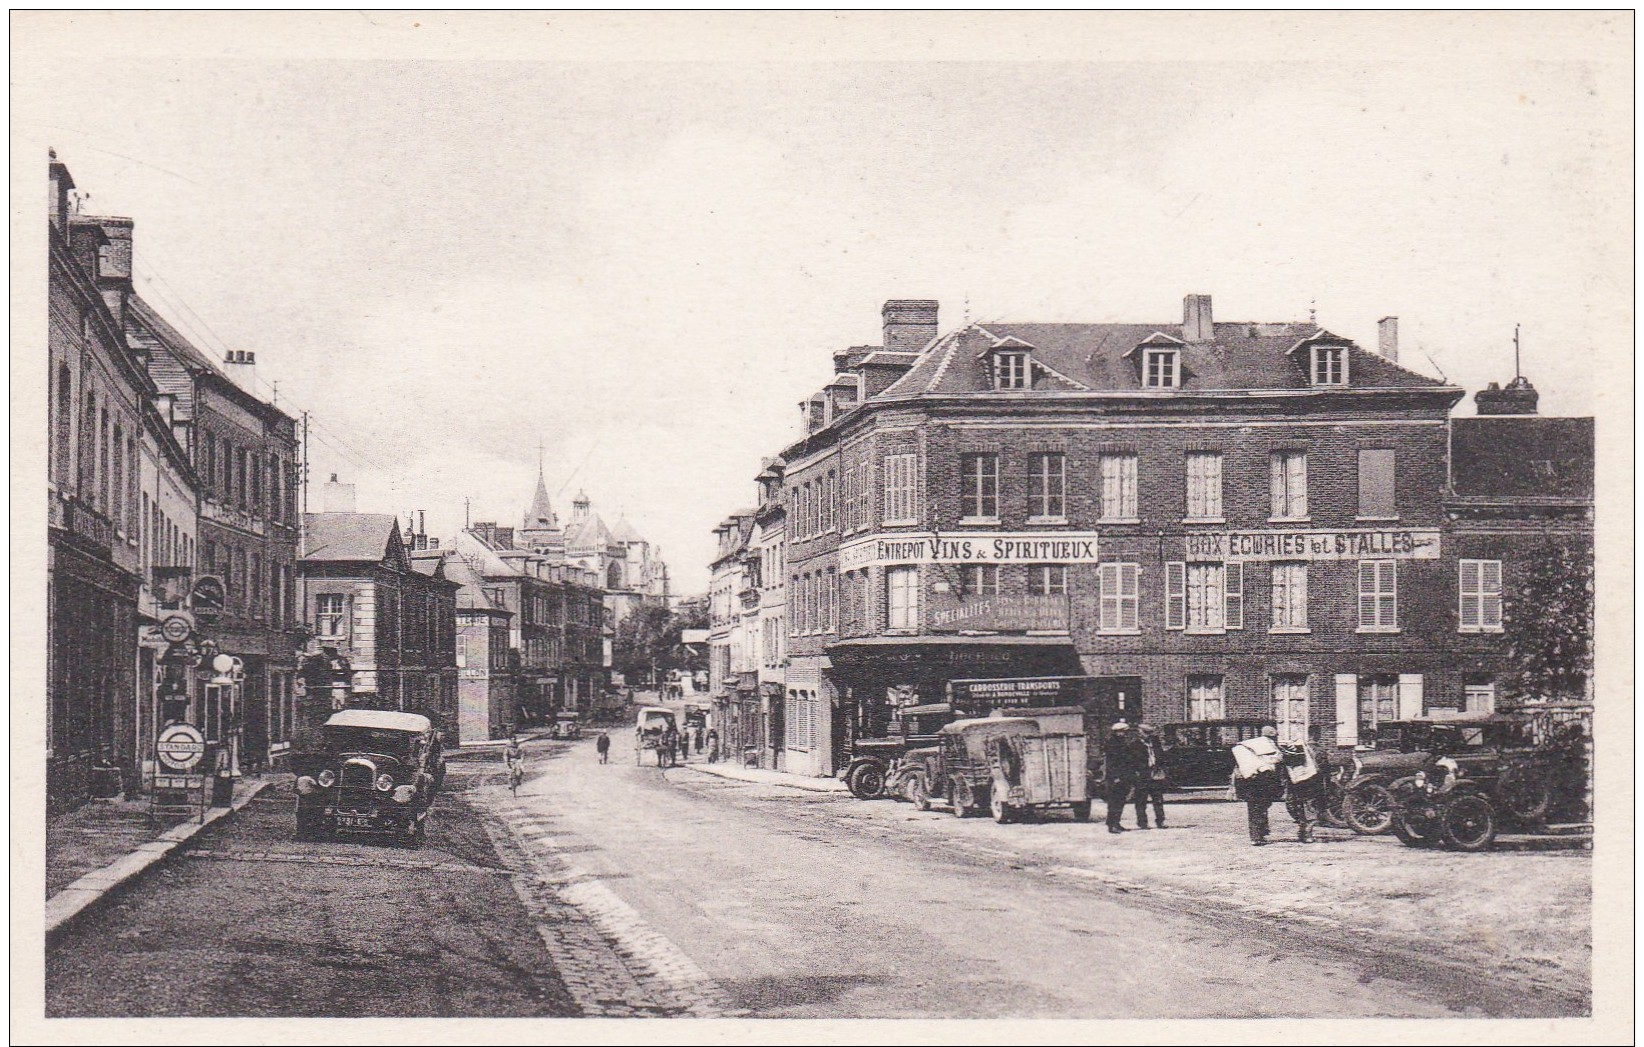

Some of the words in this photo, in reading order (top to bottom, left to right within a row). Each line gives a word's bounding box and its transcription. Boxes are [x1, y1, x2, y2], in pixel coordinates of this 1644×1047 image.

[877, 540, 925, 560] ENTREPOT
[928, 539, 972, 560] VINS
[976, 549, 988, 559] &
[993, 538, 1094, 560] SPIRITUEUX
[1335, 532, 1411, 554] STALLES
[159, 743, 203, 751] STANDARD
